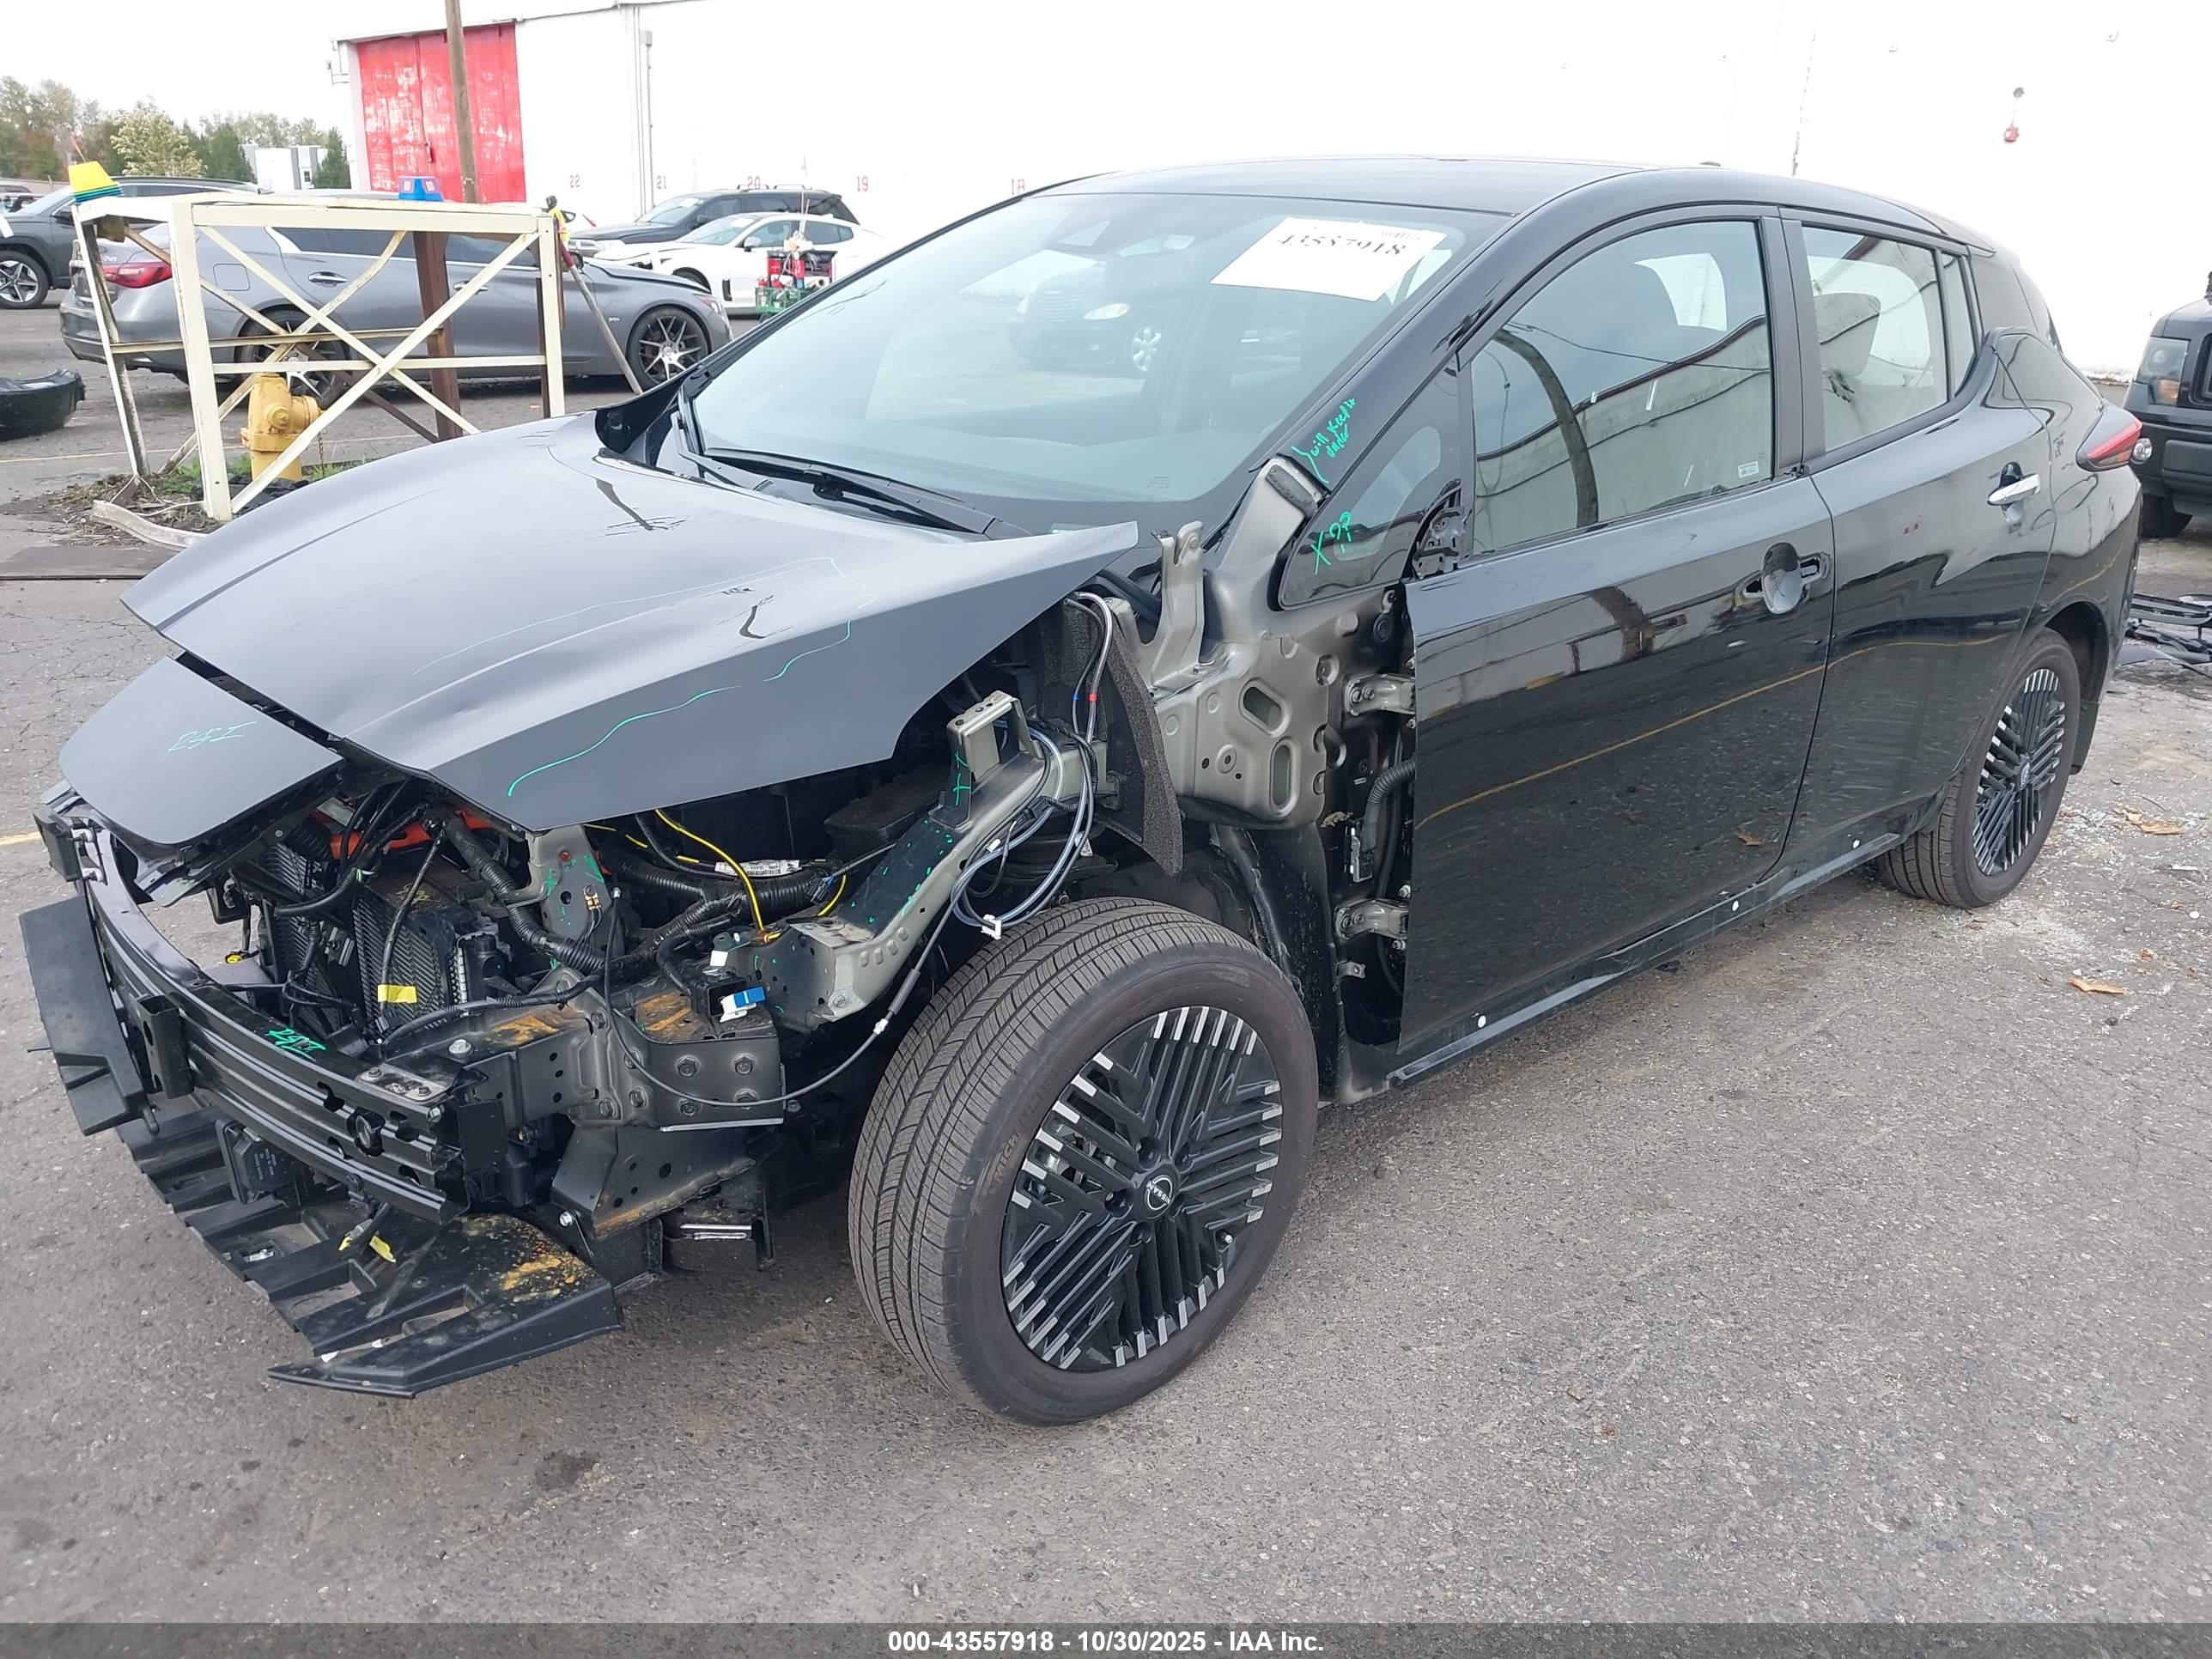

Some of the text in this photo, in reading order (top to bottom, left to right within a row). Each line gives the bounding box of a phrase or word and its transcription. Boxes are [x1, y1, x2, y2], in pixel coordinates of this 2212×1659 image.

[569, 174, 580, 188] 22
[656, 175, 667, 189] 21
[857, 176, 869, 191] 19
[1146, 1180, 1172, 1205] NISSAN
